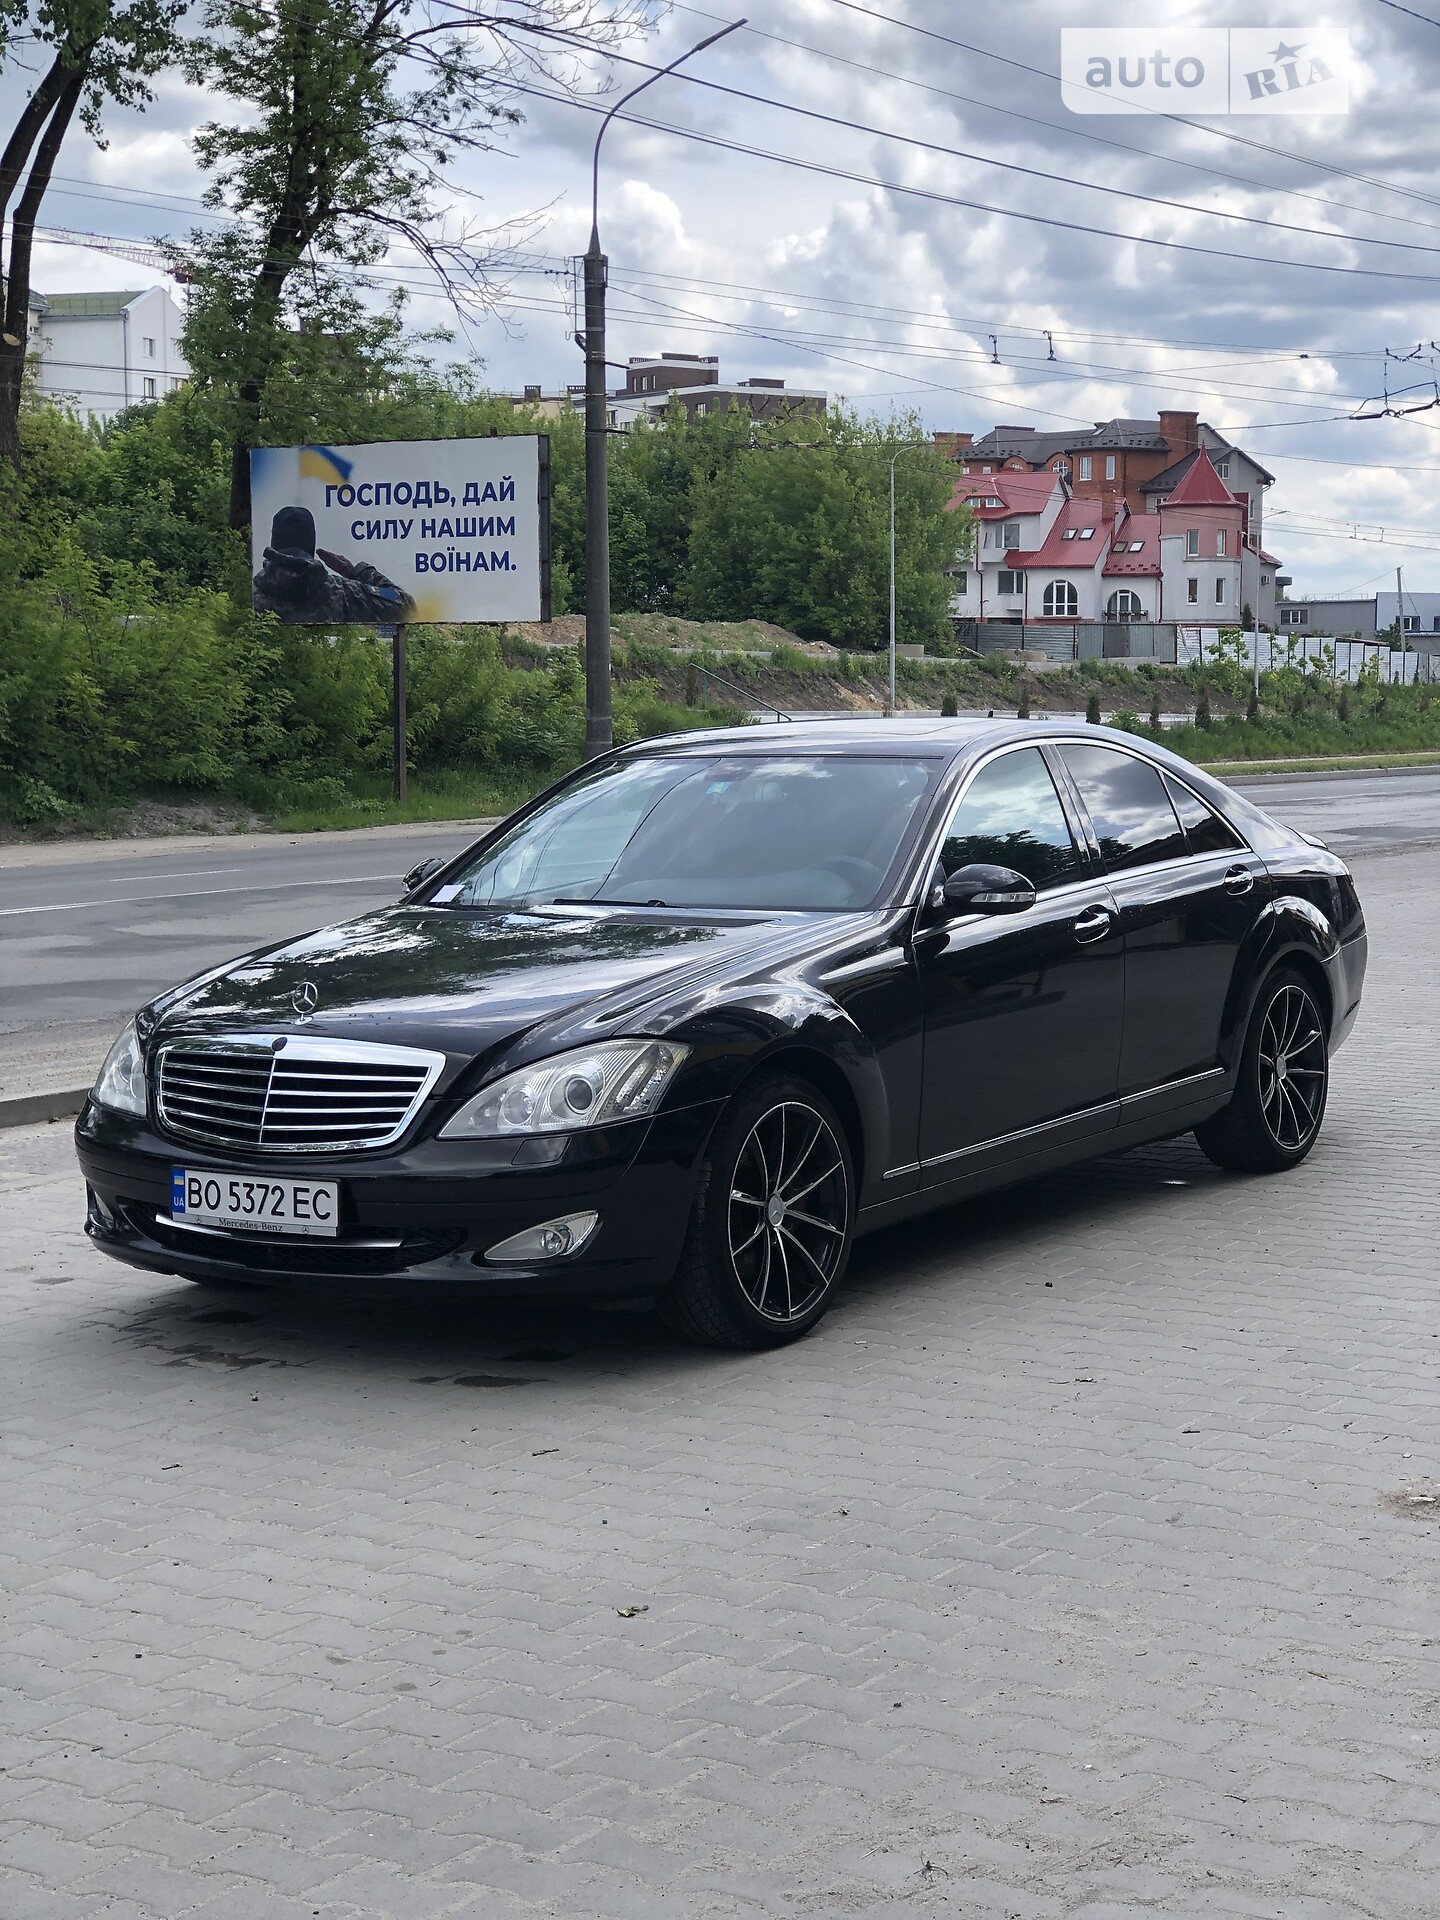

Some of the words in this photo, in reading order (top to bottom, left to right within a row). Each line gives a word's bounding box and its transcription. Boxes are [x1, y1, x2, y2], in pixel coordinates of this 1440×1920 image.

[325, 480, 456, 509] ГОСПОДЬ,
[462, 475, 515, 507] ДАЙ
[350, 518, 414, 541] СИЛУ
[421, 515, 516, 539] НАШИМ
[415, 546, 517, 573] ВОЇНАМ.
[173, 1196, 185, 1207] UA
[187, 1177, 221, 1211] BO
[228, 1181, 285, 1217] 5372
[293, 1186, 331, 1221] EC
[218, 1217, 284, 1233] Mercedes-Benz
